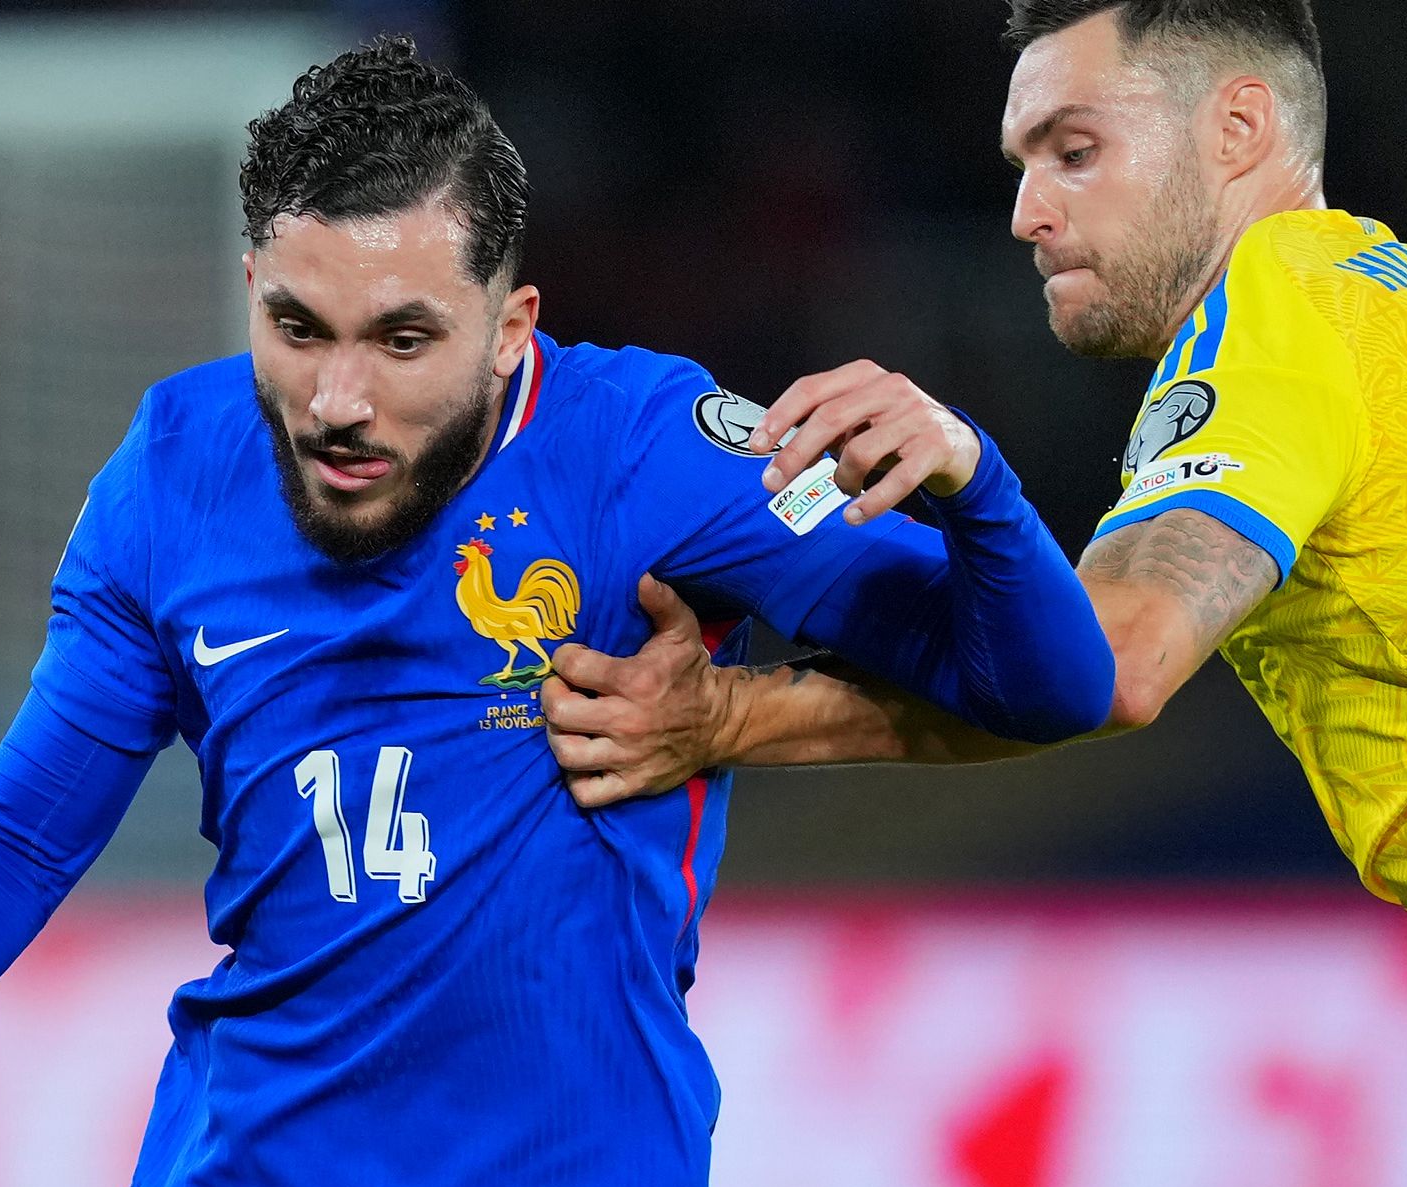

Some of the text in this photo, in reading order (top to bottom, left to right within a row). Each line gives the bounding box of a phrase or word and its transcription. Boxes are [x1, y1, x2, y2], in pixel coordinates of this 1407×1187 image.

[1179, 457, 1218, 480] 10
[773, 490, 795, 511] UEFA
[486, 704, 529, 719] FRANCE
[478, 719, 492, 730] 13
[294, 746, 437, 903] 14
